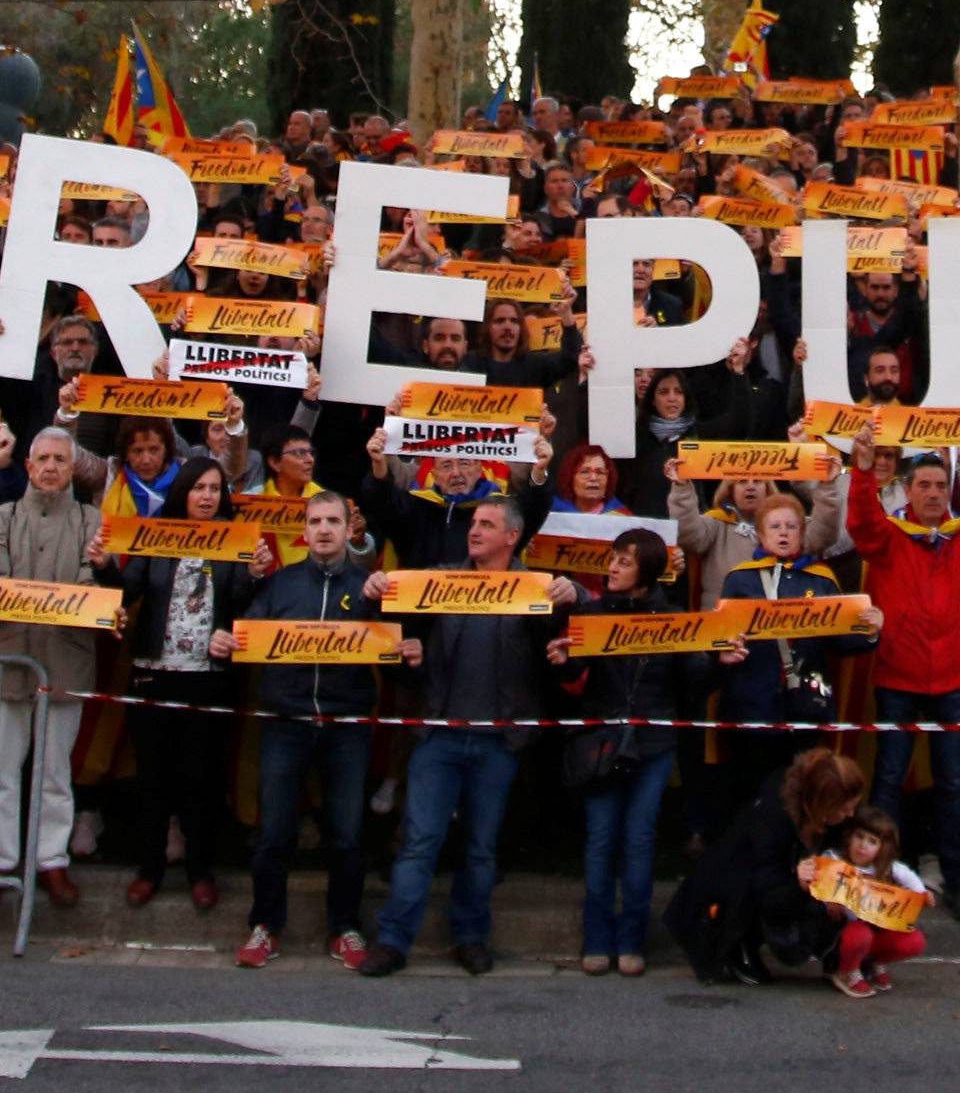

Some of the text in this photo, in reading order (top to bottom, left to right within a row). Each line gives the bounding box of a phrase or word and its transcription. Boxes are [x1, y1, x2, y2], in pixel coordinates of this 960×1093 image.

[207, 305, 297, 330] Llibertat!
[183, 344, 294, 371] LLIBERTAT
[234, 368, 292, 383] POLÍTICS!
[100, 384, 202, 409] Freedom!
[426, 390, 519, 417] Llibertat!
[402, 422, 519, 445] LLIBERTAT
[456, 444, 518, 457] POLÍTICS!
[127, 524, 230, 553] Llibertat!
[554, 542, 611, 568] Freed
[415, 577, 522, 610] Llibertat!
[744, 602, 843, 636] Llibertat!
[265, 626, 370, 661] Llibertat!
[601, 617, 705, 654] Llibertat!
